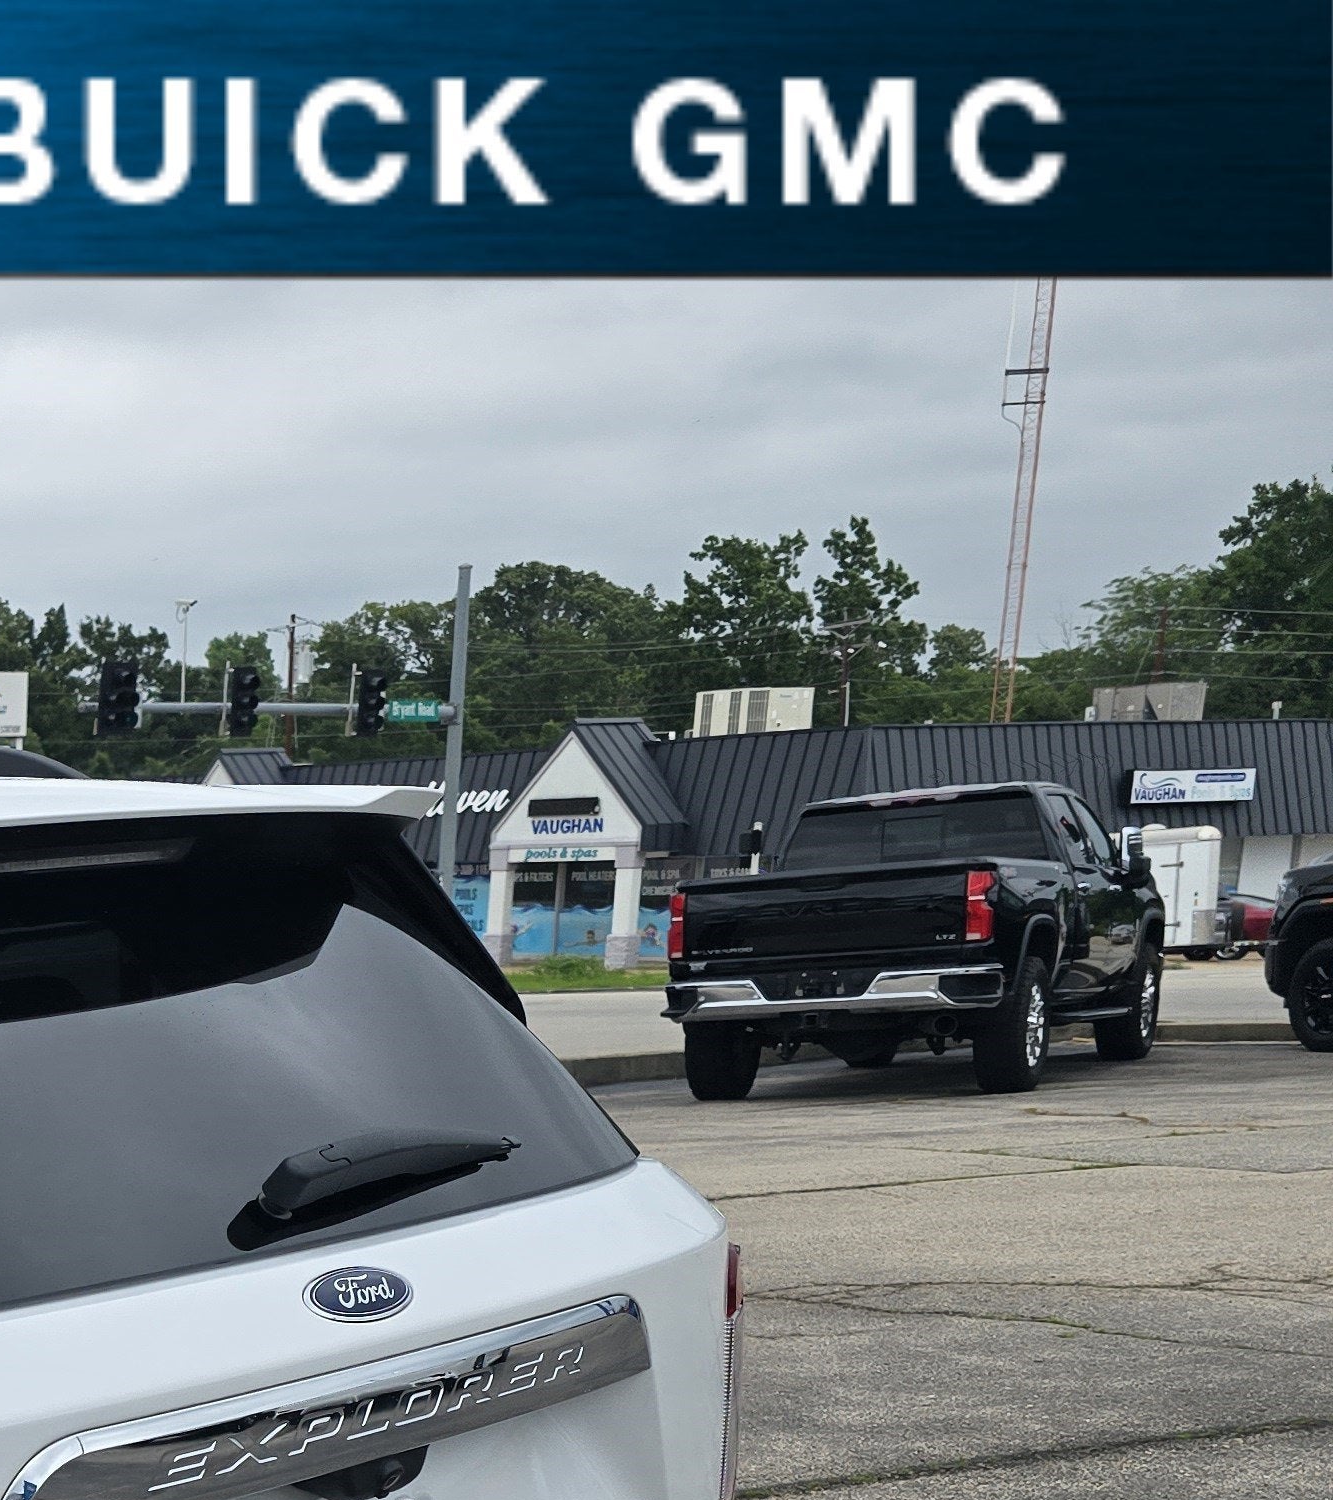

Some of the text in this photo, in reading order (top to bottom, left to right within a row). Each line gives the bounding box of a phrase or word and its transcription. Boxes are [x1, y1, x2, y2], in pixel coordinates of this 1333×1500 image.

[1134, 787, 1186, 801] VAUGHAN
[531, 818, 604, 835] VAUGHAN
[524, 846, 599, 861] pools & spas
[935, 933, 957, 941] LTZ
[333, 1273, 395, 1309] Ford
[146, 1343, 585, 1493] EXPLORER
